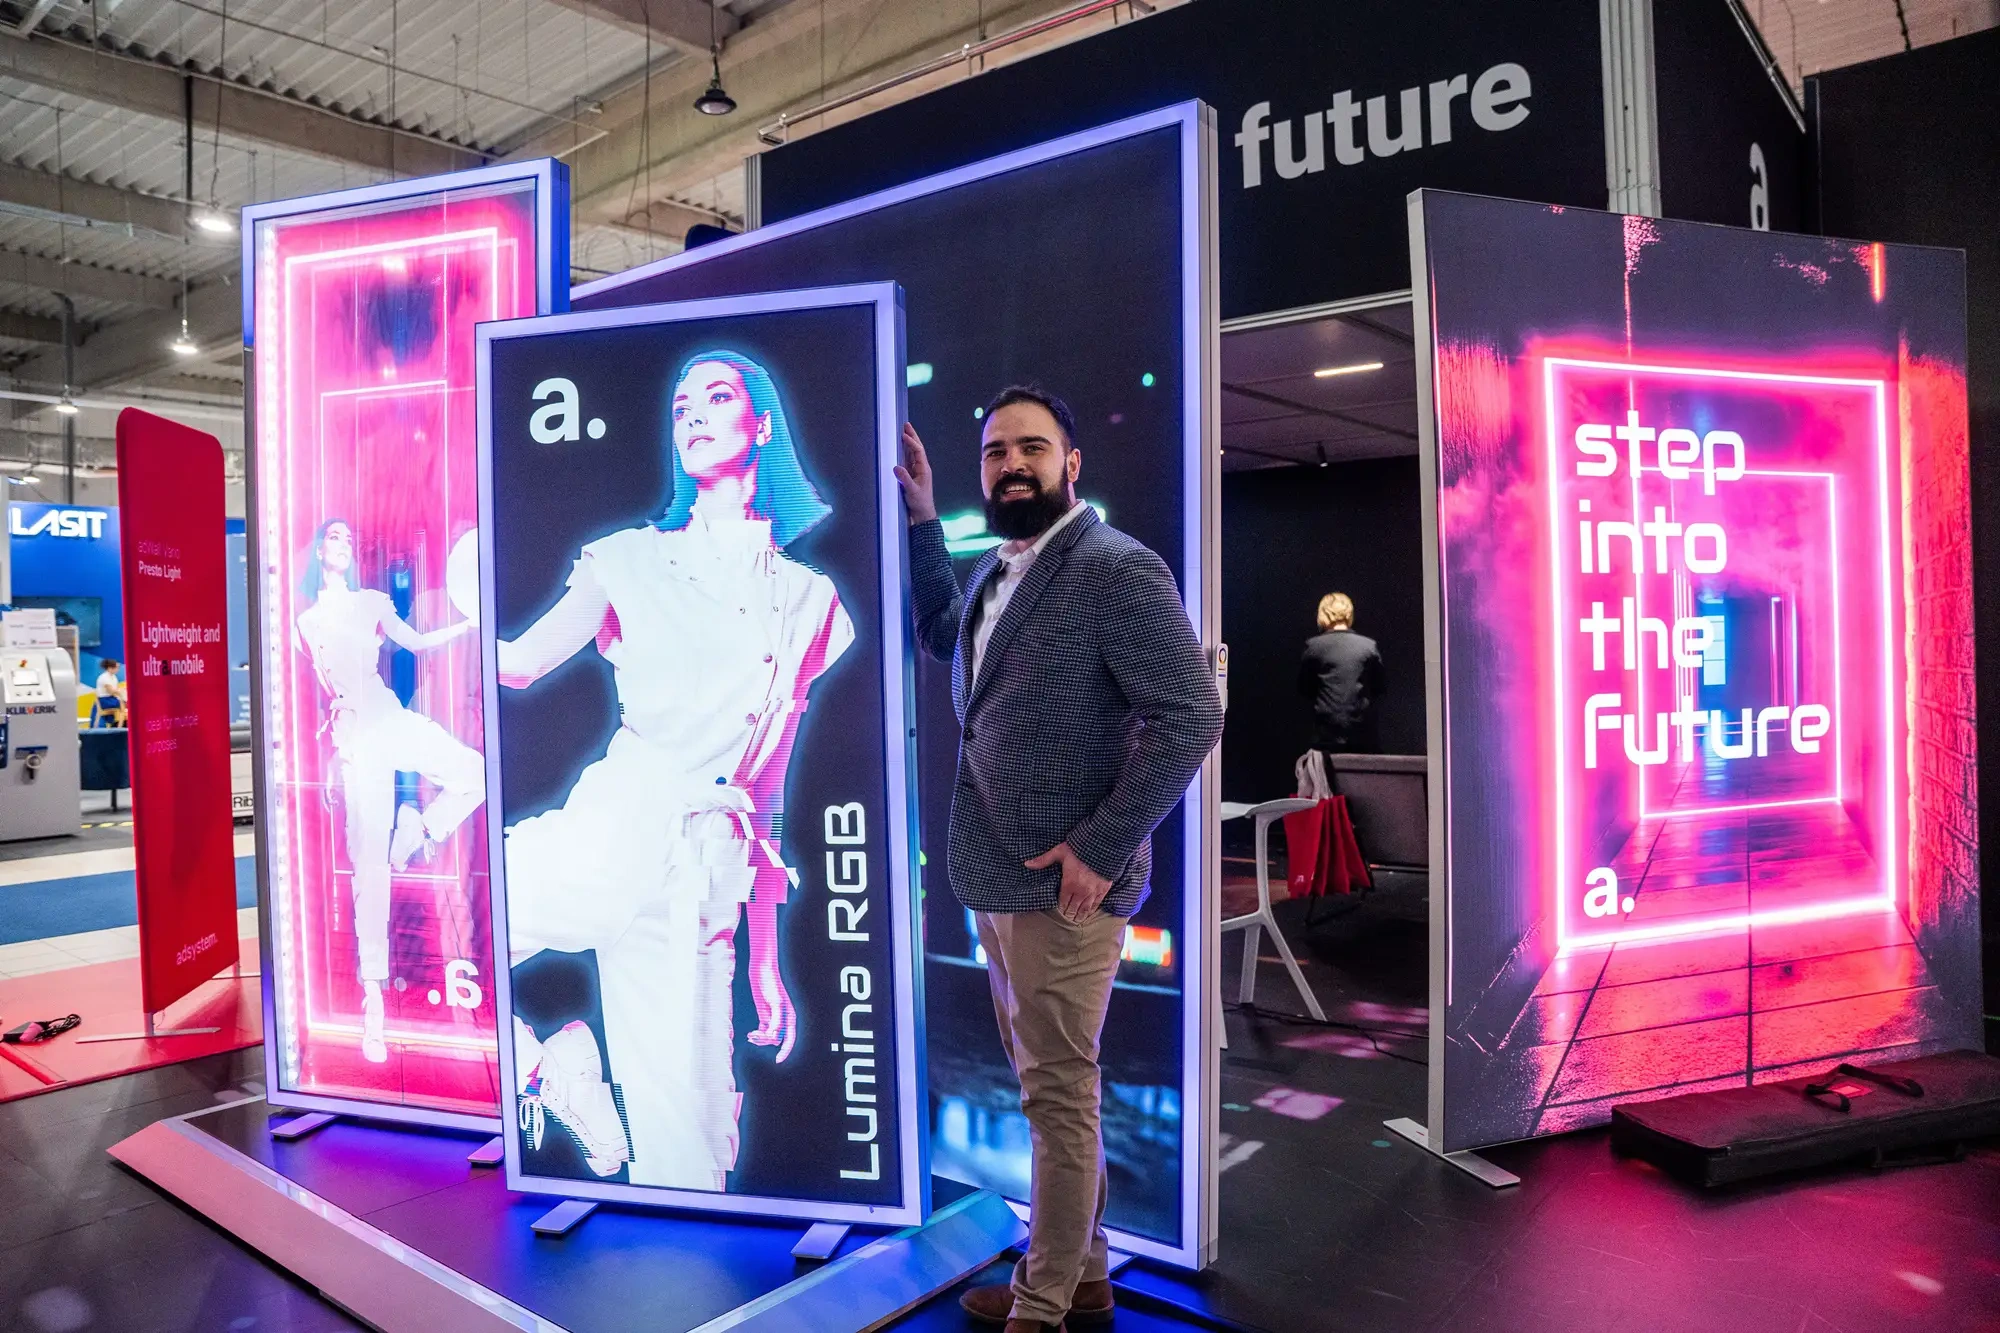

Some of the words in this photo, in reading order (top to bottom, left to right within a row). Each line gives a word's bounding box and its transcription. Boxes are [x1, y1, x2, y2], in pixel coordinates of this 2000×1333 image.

[1234, 62, 1532, 190] future
[1749, 142, 1769, 232] a
[528, 376, 607, 446] a.
[1574, 410, 1746, 496] step
[10, 507, 108, 538] LASIT
[1578, 499, 1728, 575] into
[138, 560, 163, 577] Presto
[164, 564, 182, 582] Light
[141, 621, 202, 648] Lightweight
[203, 622, 221, 643] and
[142, 654, 169, 677] ultra
[171, 653, 205, 675] mobile
[1579, 596, 1715, 672] the
[824, 800, 870, 942] RGB
[1582, 866, 1636, 919] a.
[830, 964, 881, 1181] Lumina
